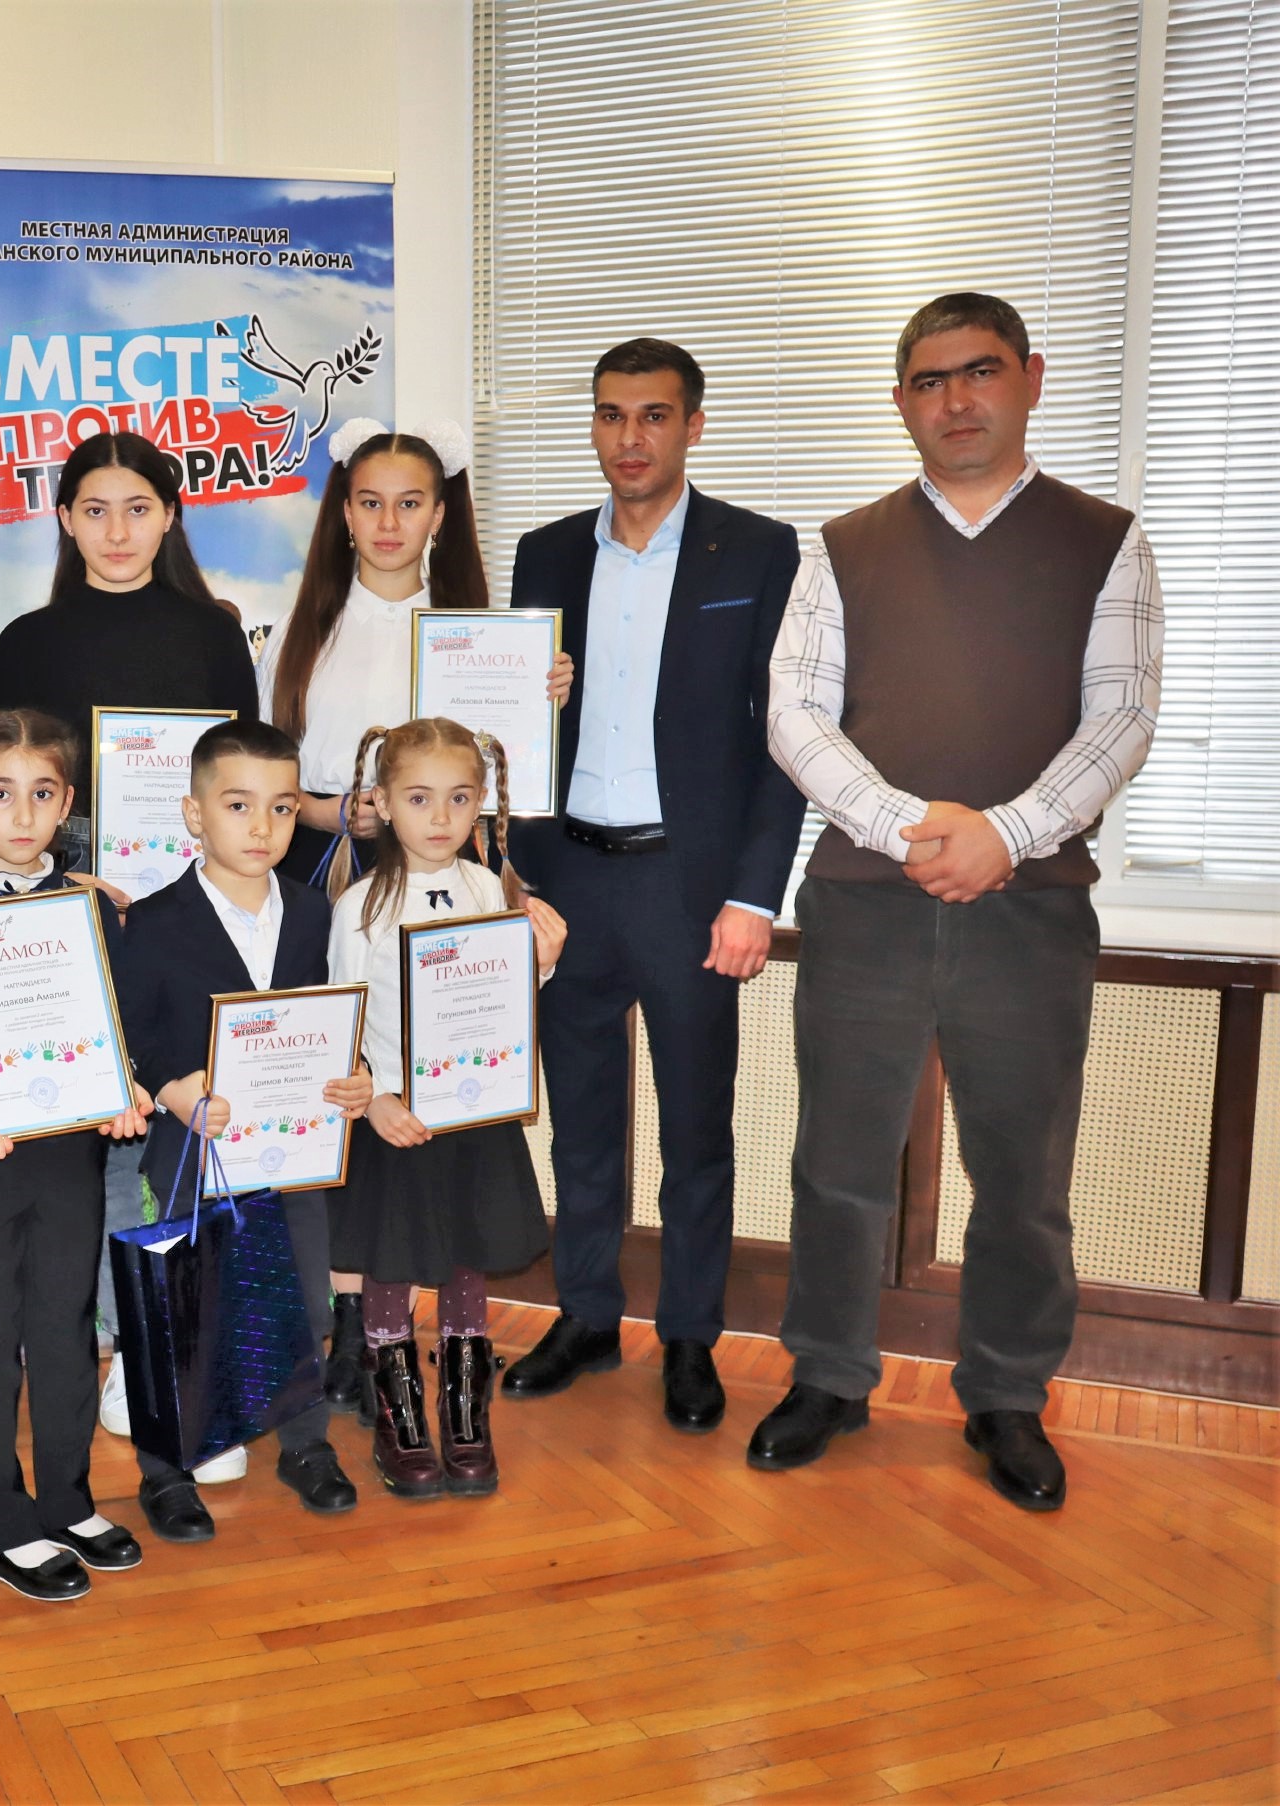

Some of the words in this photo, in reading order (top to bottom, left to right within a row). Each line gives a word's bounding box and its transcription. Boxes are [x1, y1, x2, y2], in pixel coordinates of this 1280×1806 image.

[20, 220, 113, 239] МЕСТНАЯ
[118, 224, 290, 247] АДМИНИСТРАЦИЯ
[85, 246, 272, 267] МУНИЦИПАЛЬНОГО
[278, 249, 354, 269] РАЙОНА
[12, 441, 272, 513] ТЕРА!
[447, 653, 526, 667] ГРАМОТА
[450, 697, 483, 705] Абазова
[126, 753, 192, 768] ГРАМОТ
[435, 958, 508, 981] ГРАМОТА
[3, 977, 52, 990] НАГРАЖДАЕТСЯ
[36, 990, 70, 1002] Амалия
[478, 1003, 506, 1014] Ясмина
[245, 1032, 328, 1052] ГРАМОТА
[250, 1077, 282, 1088] Цримов
[284, 1075, 313, 1084] Каплан
